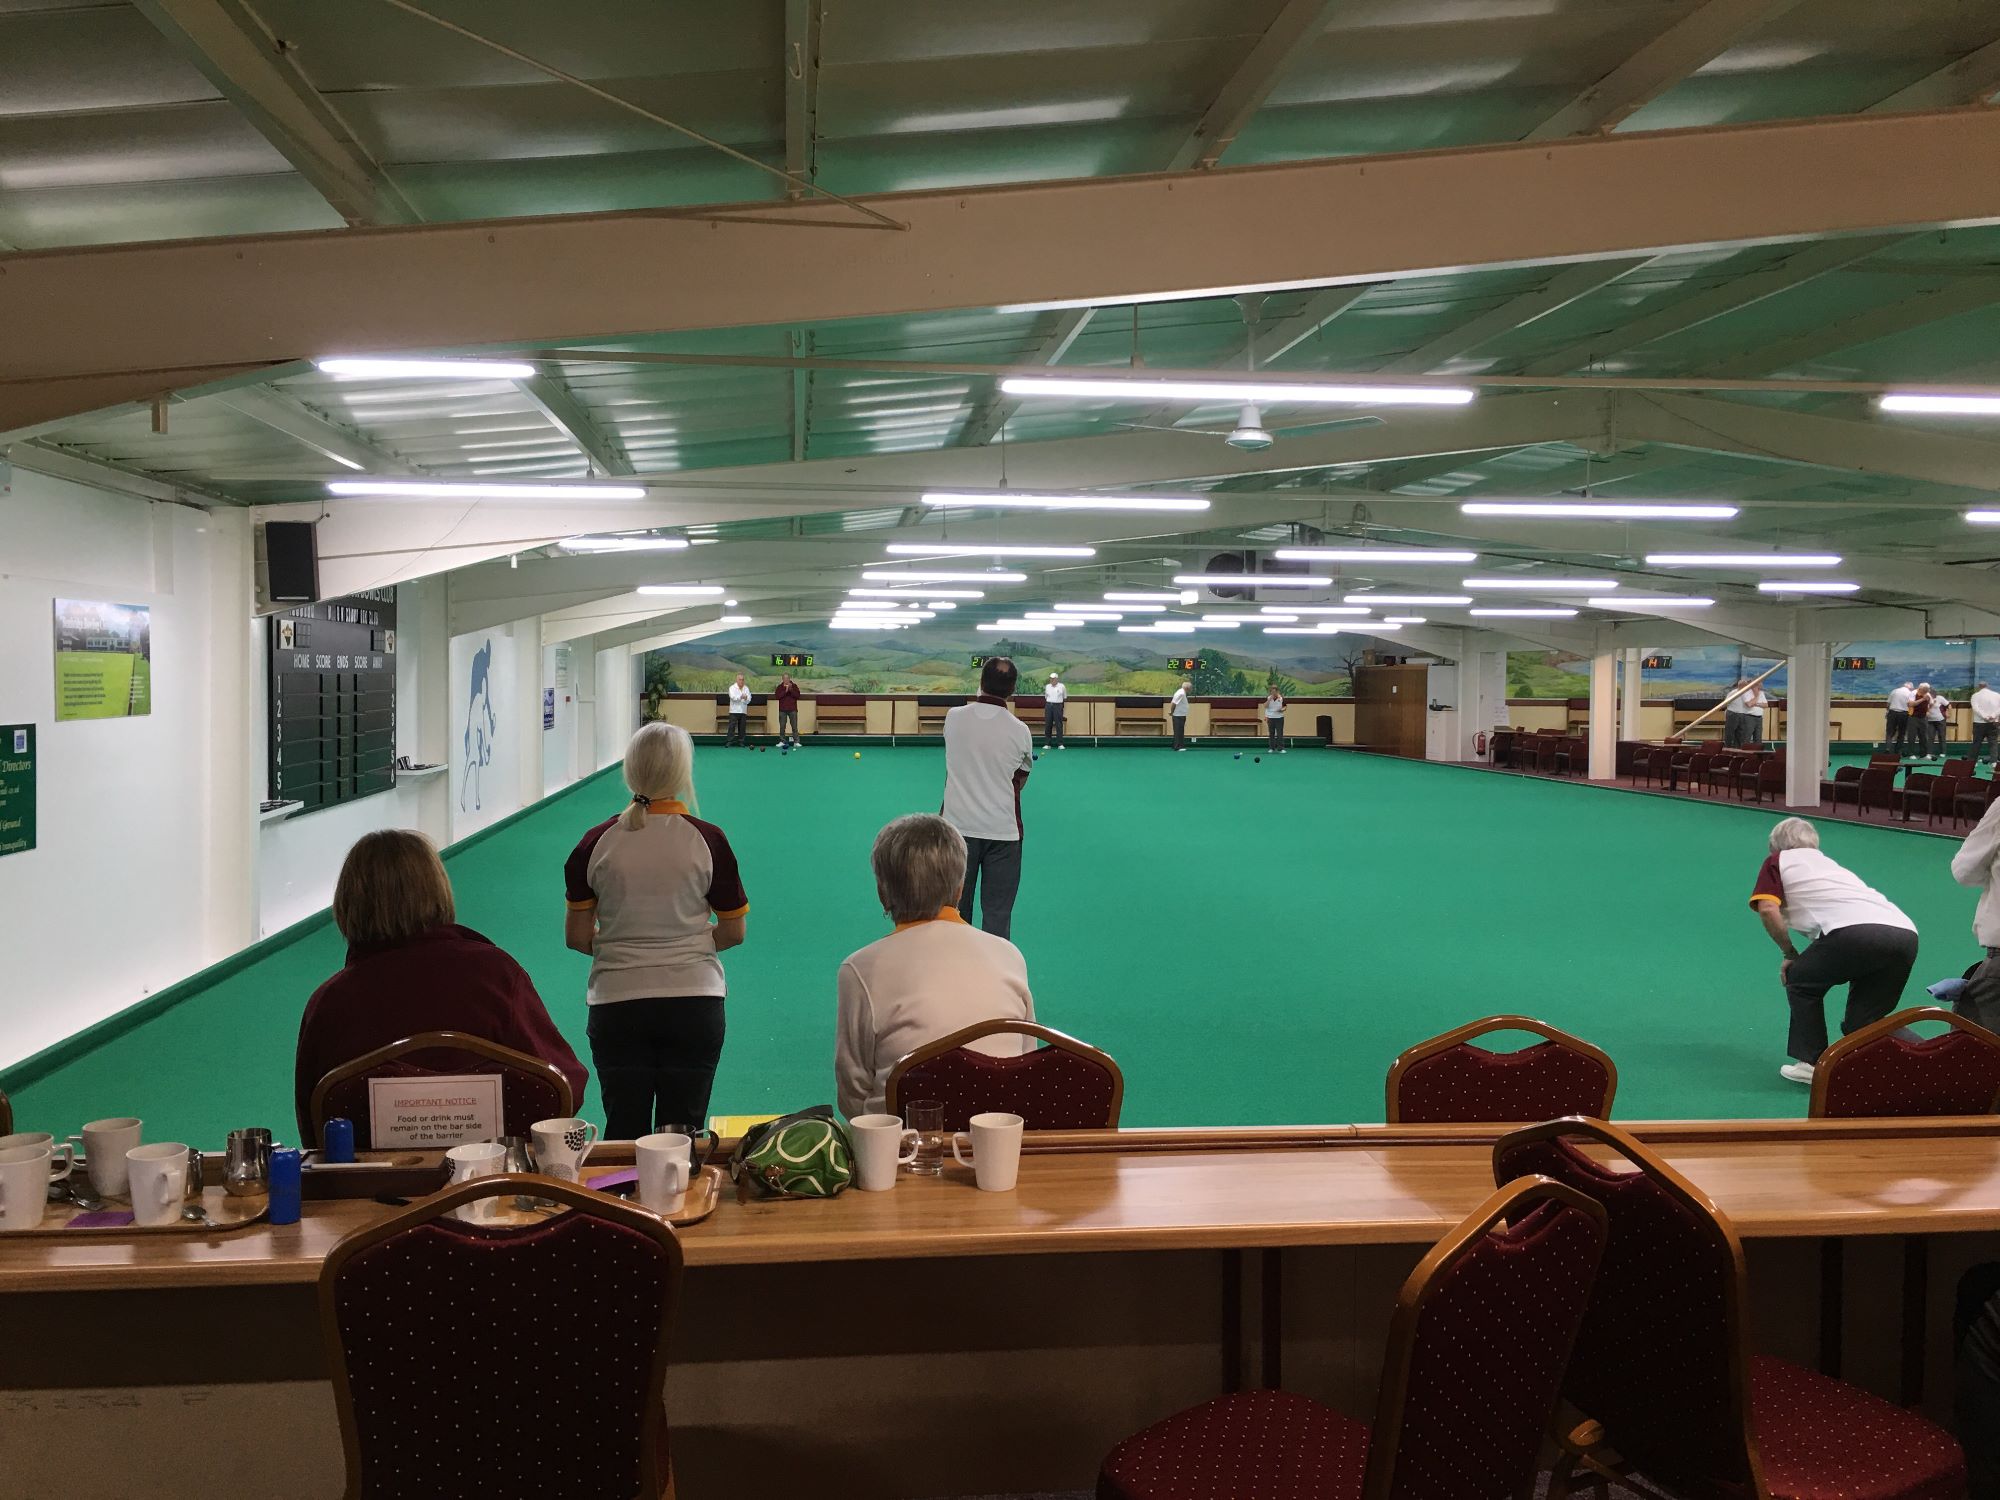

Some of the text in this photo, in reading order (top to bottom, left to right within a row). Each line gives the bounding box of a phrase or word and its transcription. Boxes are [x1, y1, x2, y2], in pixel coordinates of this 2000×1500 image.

[293, 653, 310, 669] HOME
[315, 654, 331, 669] SCORE
[336, 655, 349, 669] ENDS
[354, 656, 368, 669] SCORE
[1167, 658, 1179, 669] 22
[394, 1097, 477, 1108] IMPORTANT NOTICE
[397, 1115, 417, 1123] Food
[430, 1114, 451, 1122] drink
[453, 1113, 474, 1121] must
[465, 1122, 482, 1130] side
[409, 1133, 418, 1141] of
[436, 1132, 463, 1140] barrier
